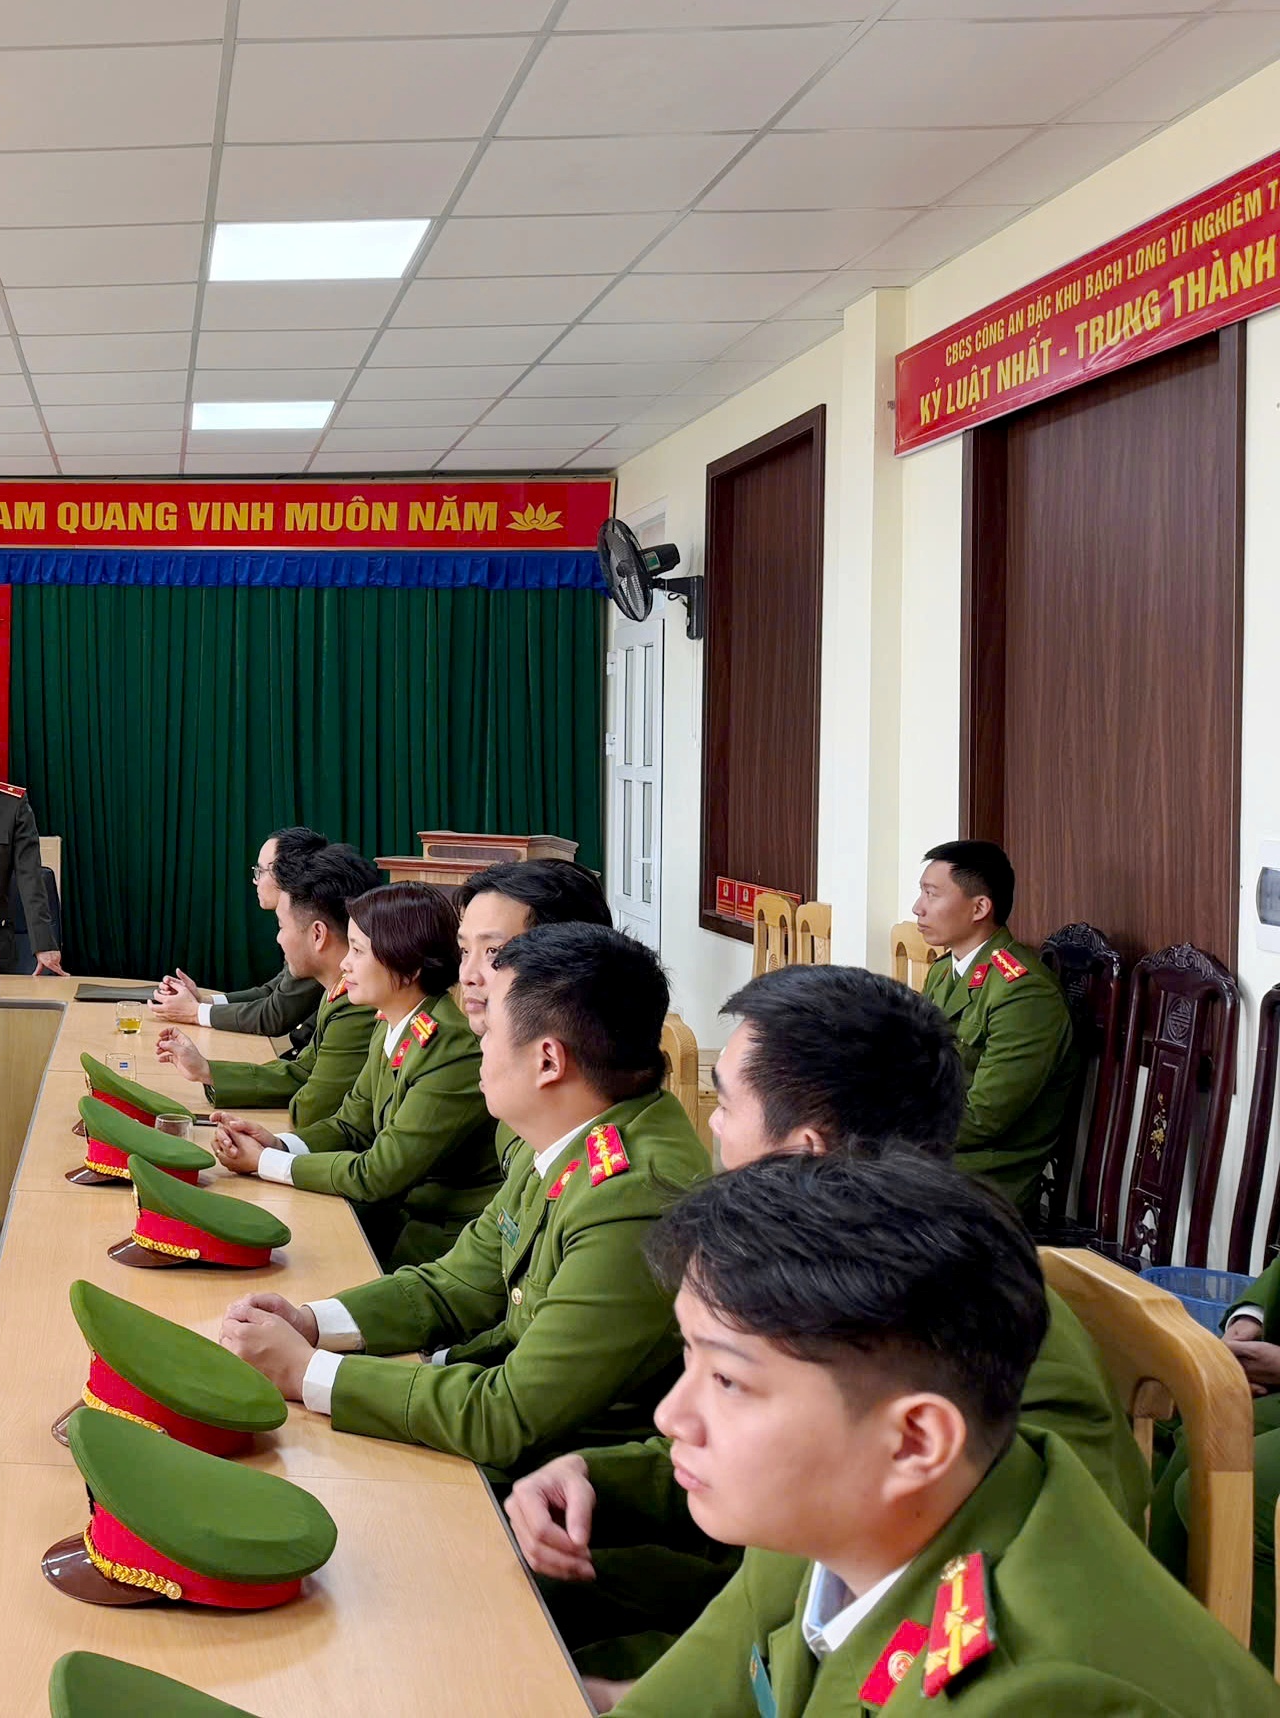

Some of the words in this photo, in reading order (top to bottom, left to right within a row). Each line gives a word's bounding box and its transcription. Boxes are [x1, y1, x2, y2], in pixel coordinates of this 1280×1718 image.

[920, 377, 942, 426] KỶ
[946, 365, 991, 415] LUẬT
[997, 330, 1052, 394] NHẤT
[1075, 289, 1161, 359] TRUNG
[1168, 234, 1277, 319] THÀNH
[946, 335, 972, 366] CBCS
[975, 318, 1005, 352] CÔNG
[1008, 308, 1024, 338] AN
[1027, 294, 1052, 329] ĐẶC
[1055, 280, 1081, 314] KHU
[1085, 259, 1122, 300] BẠCH
[1127, 237, 1167, 280] LONG
[1171, 220, 1187, 258] VĨ
[1191, 188, 1262, 248] NGHIÊM
[1268, 178, 1280, 210] T
[57, 501, 178, 534] QUANG
[188, 501, 274, 531] VINH
[284, 495, 398, 532] MUÔN
[407, 495, 498, 531] NĂM
